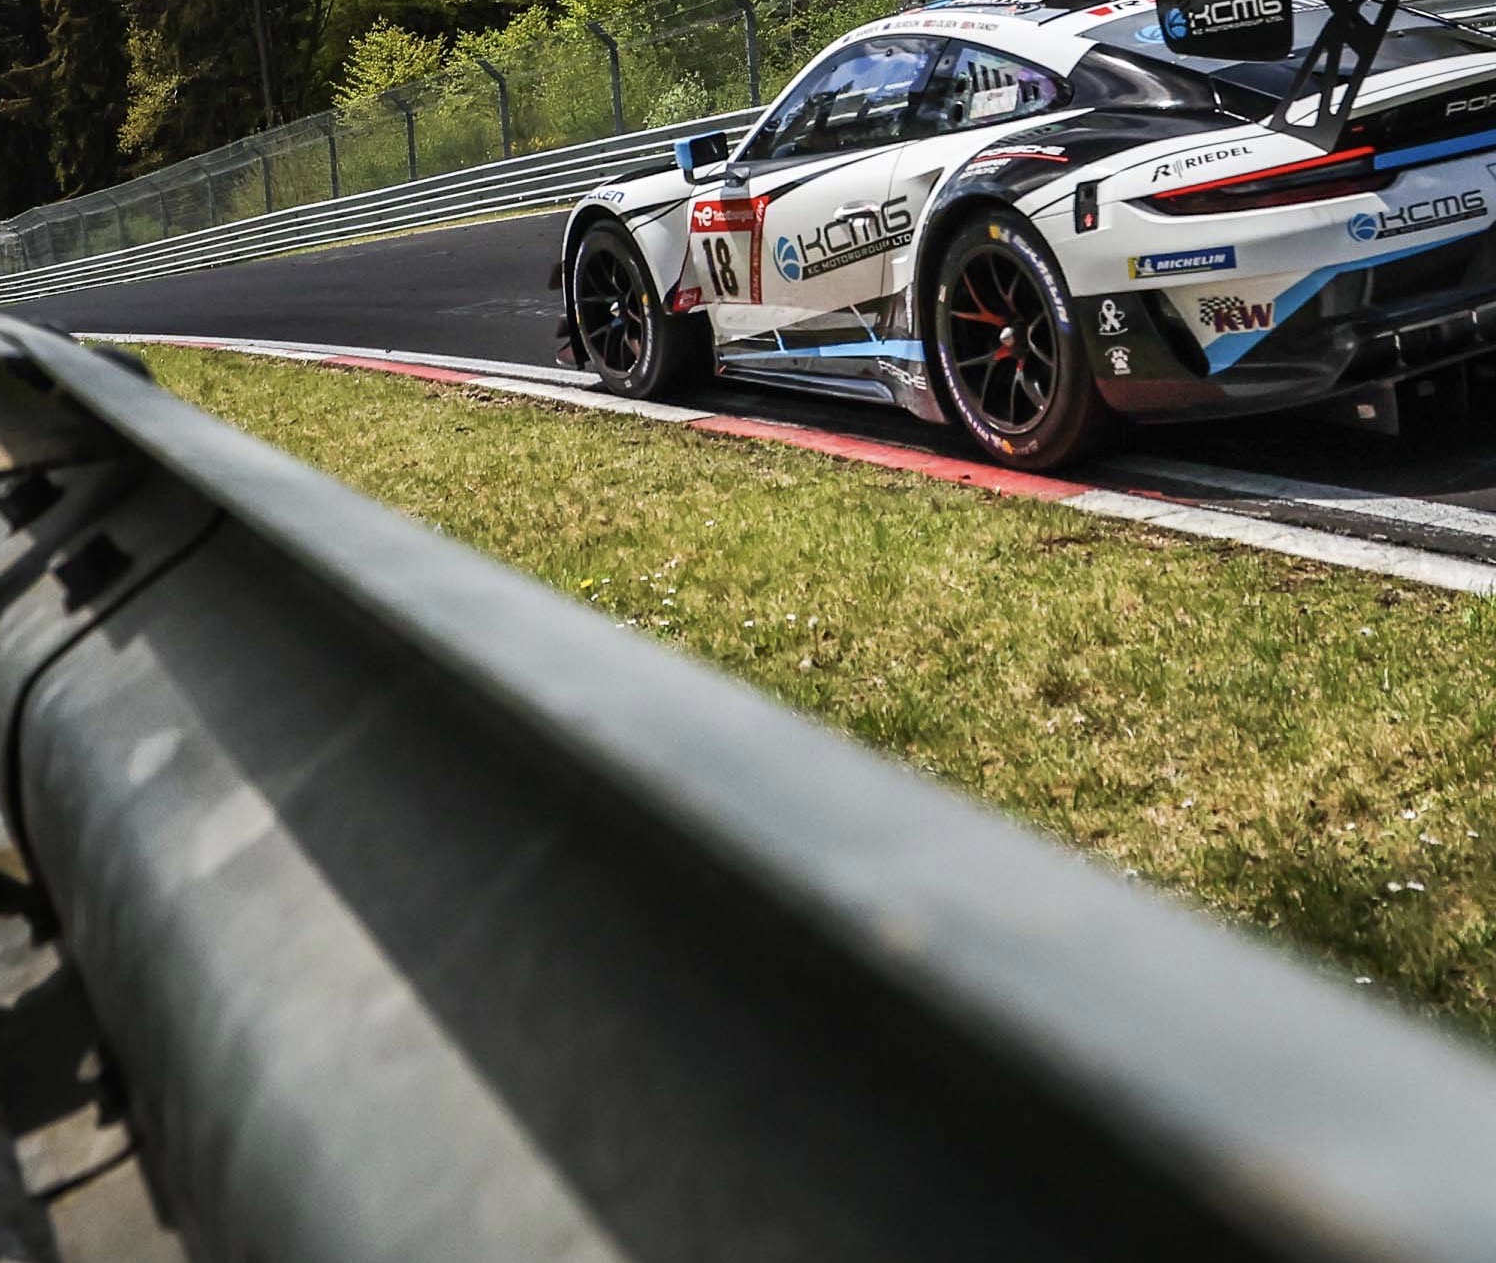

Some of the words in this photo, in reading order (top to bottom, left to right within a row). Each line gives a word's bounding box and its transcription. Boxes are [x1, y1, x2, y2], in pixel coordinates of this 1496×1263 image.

[1185, 146, 1254, 170] RIEDEL
[1378, 189, 1484, 229] KCMG
[796, 194, 912, 264] KCMG
[702, 237, 739, 297] 18
[1156, 253, 1227, 271] MICHELIN
[1213, 302, 1274, 333] KW
